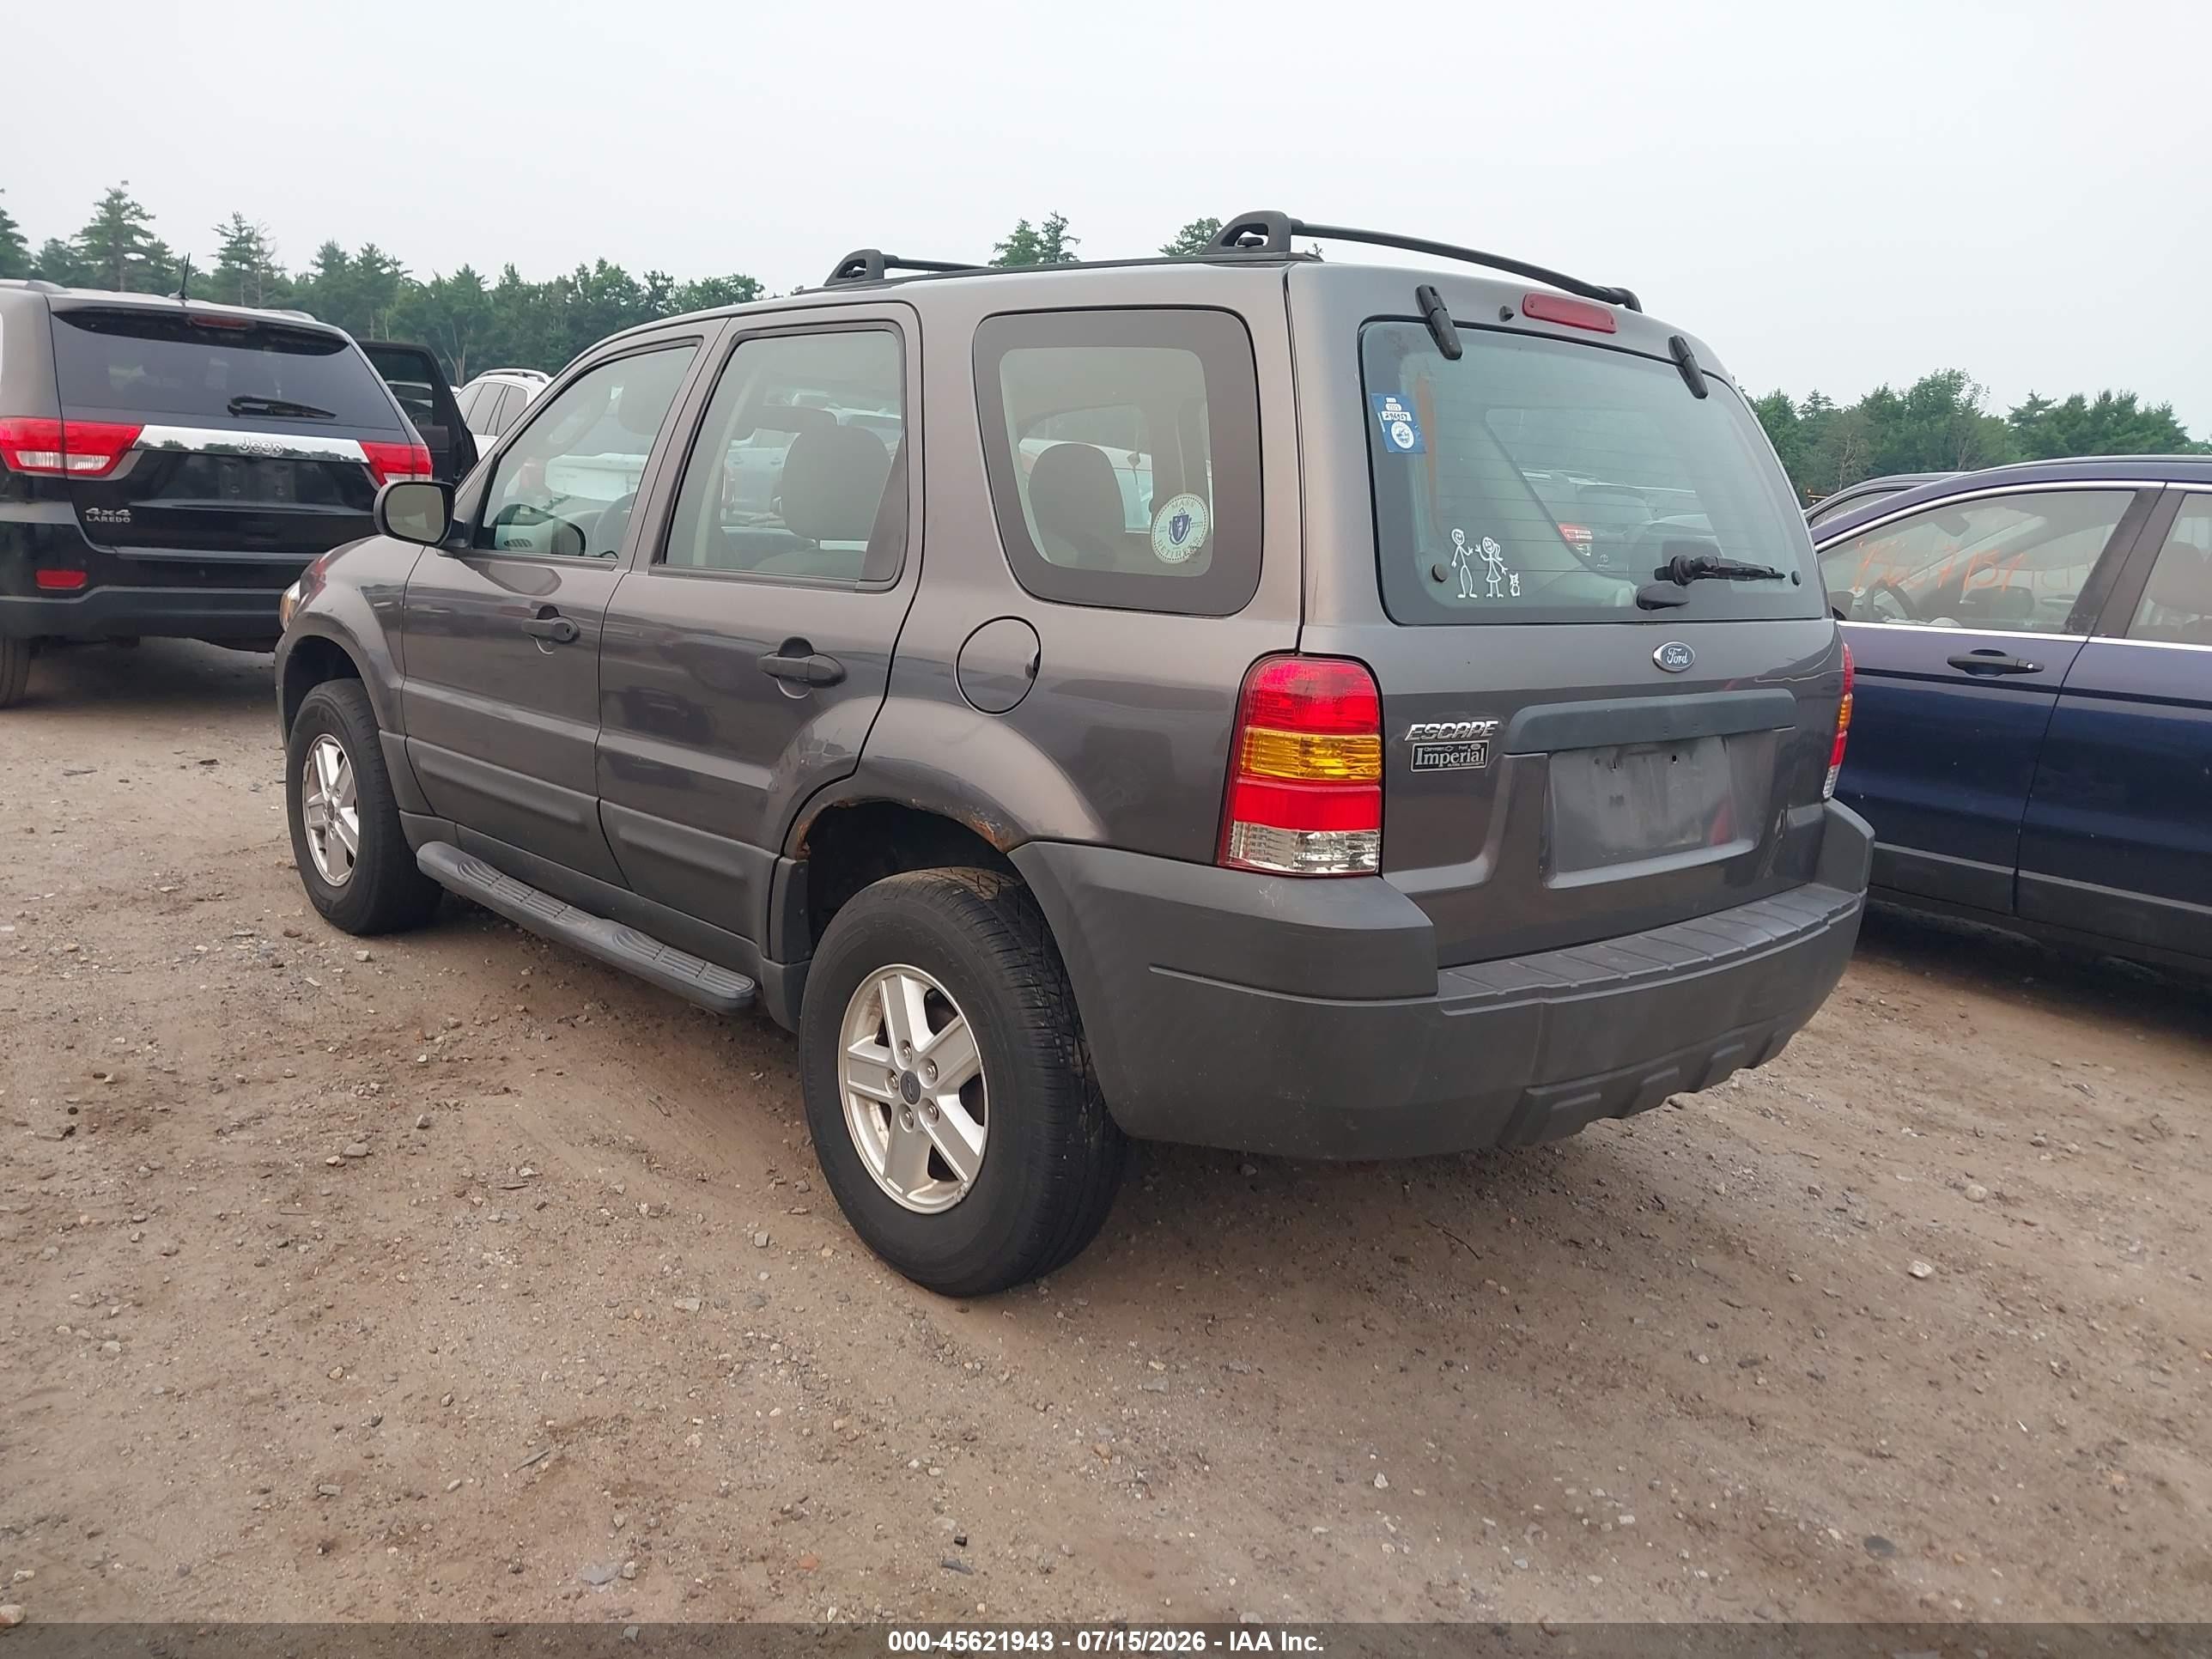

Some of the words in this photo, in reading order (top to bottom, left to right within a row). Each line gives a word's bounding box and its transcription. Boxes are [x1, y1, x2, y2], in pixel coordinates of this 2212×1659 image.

[238, 437, 283, 456] Jeep
[86, 514, 131, 524] LAREDO
[1666, 647, 1689, 665] Ford
[1404, 720, 1499, 741] ESCAPE
[1414, 747, 1486, 768] Imperial
